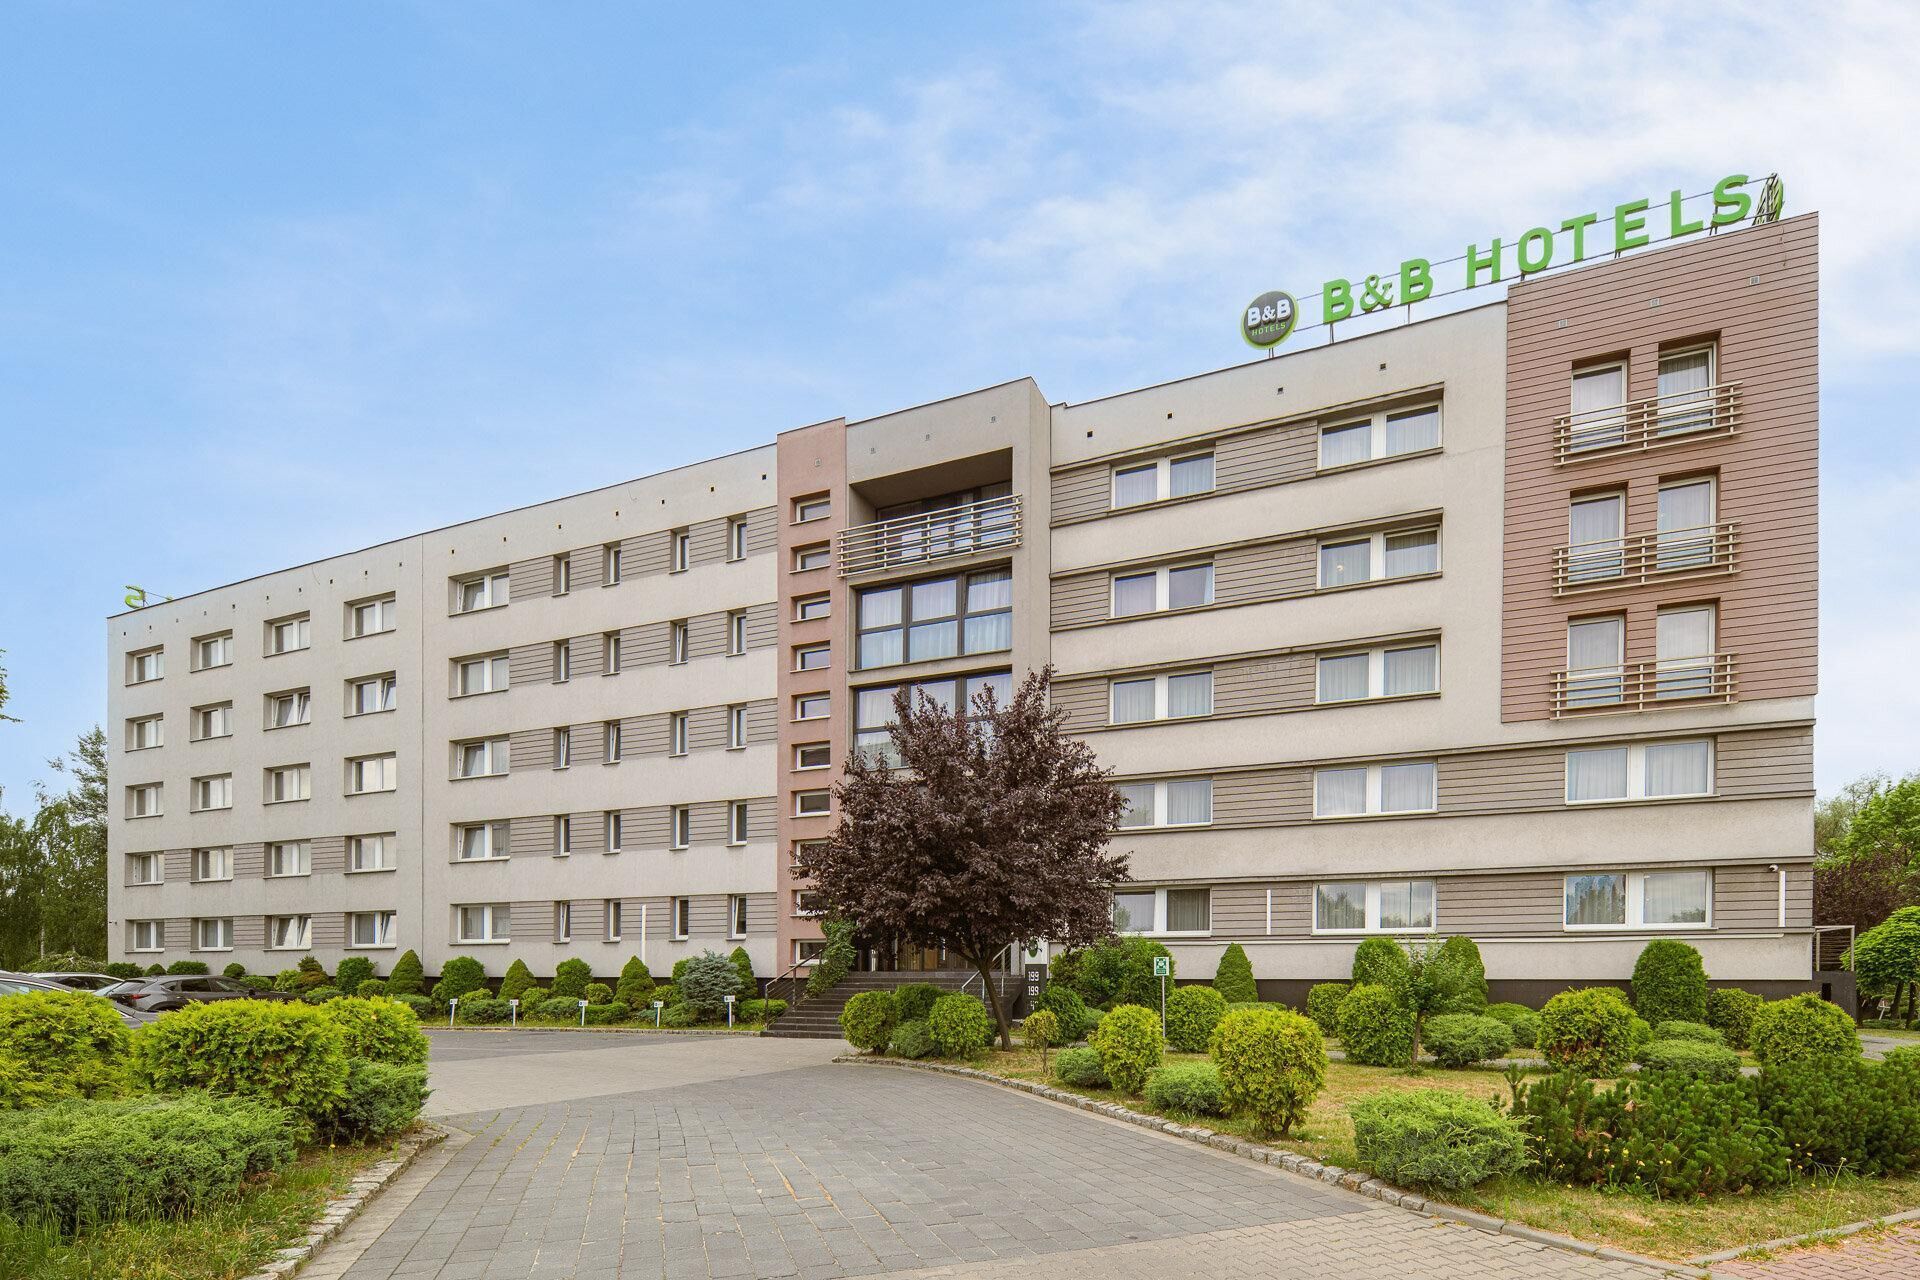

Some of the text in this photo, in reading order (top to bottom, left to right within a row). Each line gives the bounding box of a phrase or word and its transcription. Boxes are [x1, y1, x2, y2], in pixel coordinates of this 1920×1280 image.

[1322, 174, 1752, 325] B&B HOTELS
[1247, 299, 1291, 327] B&B
[1251, 322, 1287, 336] HOTELS
